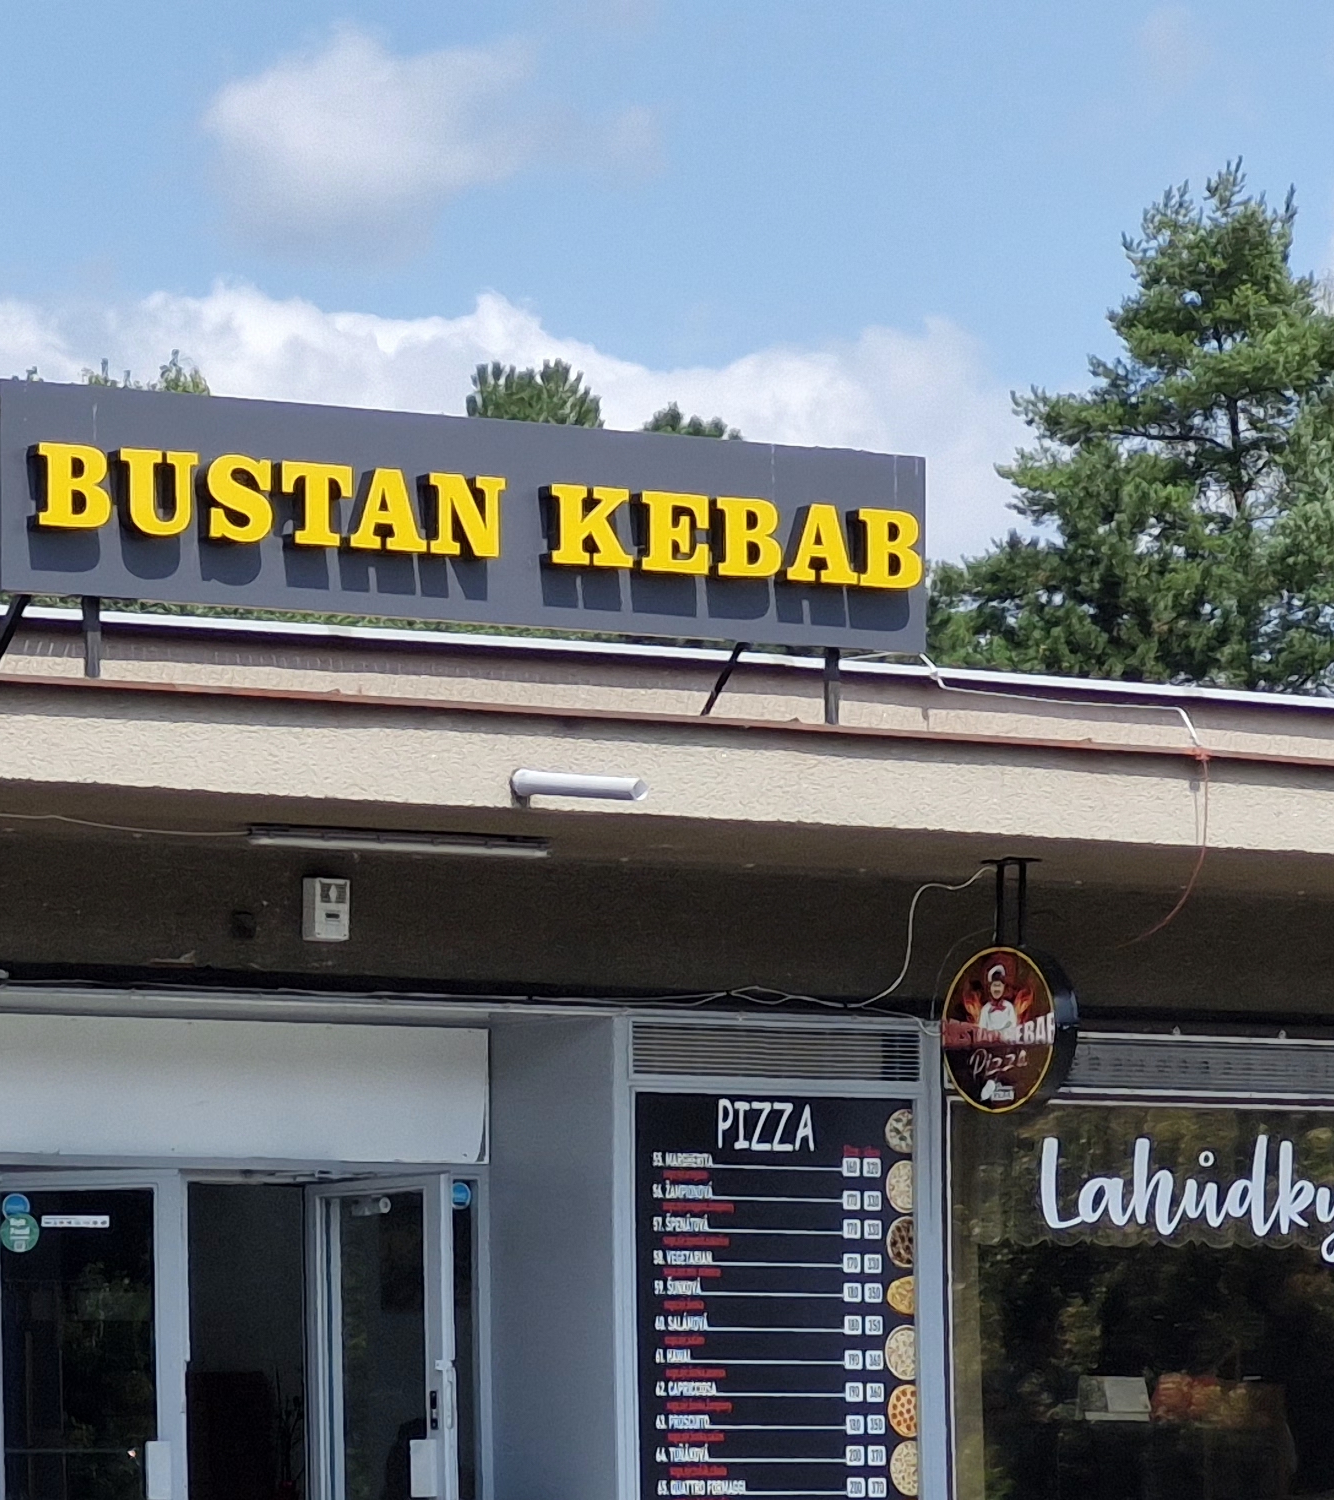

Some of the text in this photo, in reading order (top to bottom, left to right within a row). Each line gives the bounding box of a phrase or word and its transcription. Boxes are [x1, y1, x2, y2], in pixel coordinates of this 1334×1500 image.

[31, 441, 923, 591] BUSTAN KEBAB
[969, 1048, 1028, 1081] Pizza
[717, 1098, 815, 1152] PIZZA
[670, 1479, 706, 1496] QUATTRO
